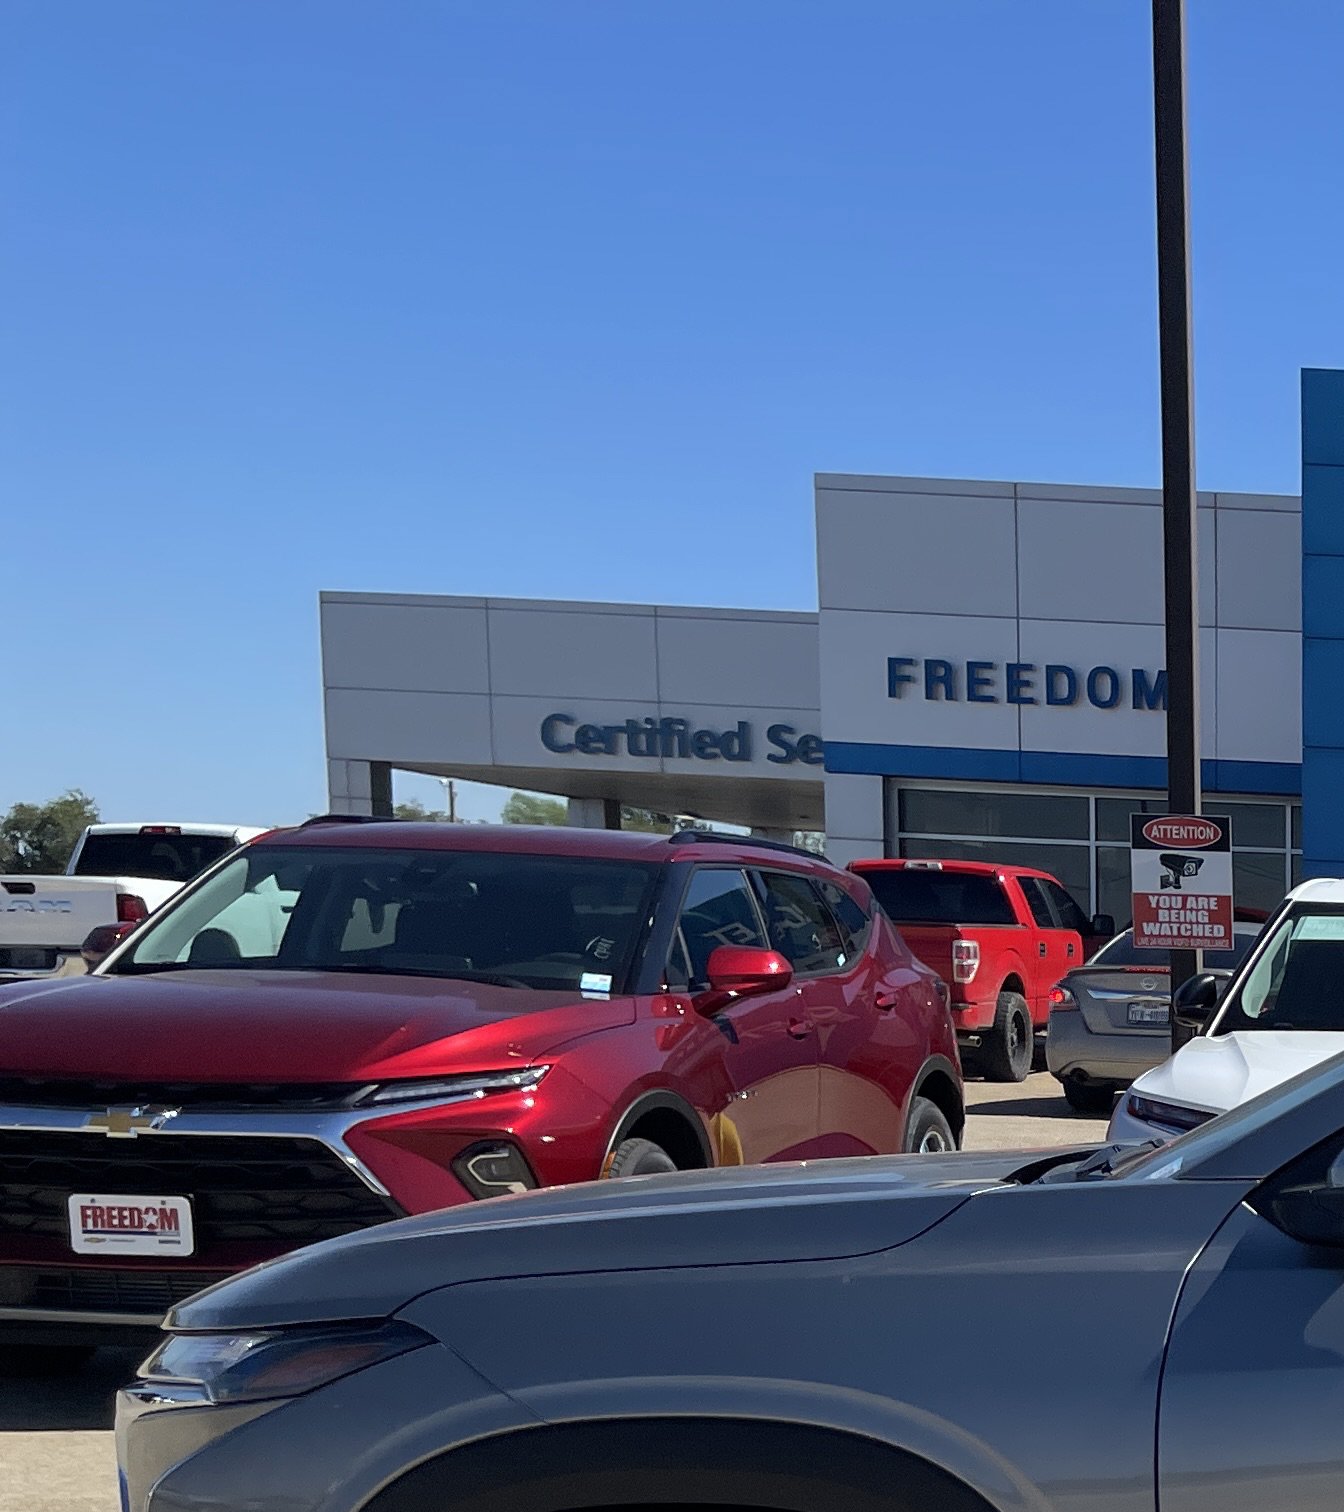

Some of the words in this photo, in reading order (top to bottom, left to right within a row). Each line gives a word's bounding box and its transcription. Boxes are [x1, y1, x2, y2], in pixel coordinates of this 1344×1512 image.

[887, 656, 1168, 710] FREEDOM
[541, 713, 751, 763] Certified
[766, 724, 823, 765] Se
[1150, 824, 1214, 841] ATTENTION
[1148, 895, 1183, 909] YOU
[1186, 896, 1218, 910] ARE
[1158, 909, 1209, 923] BEING
[1142, 922, 1225, 937] WATCHED
[80, 1205, 180, 1231] FREEDOM
